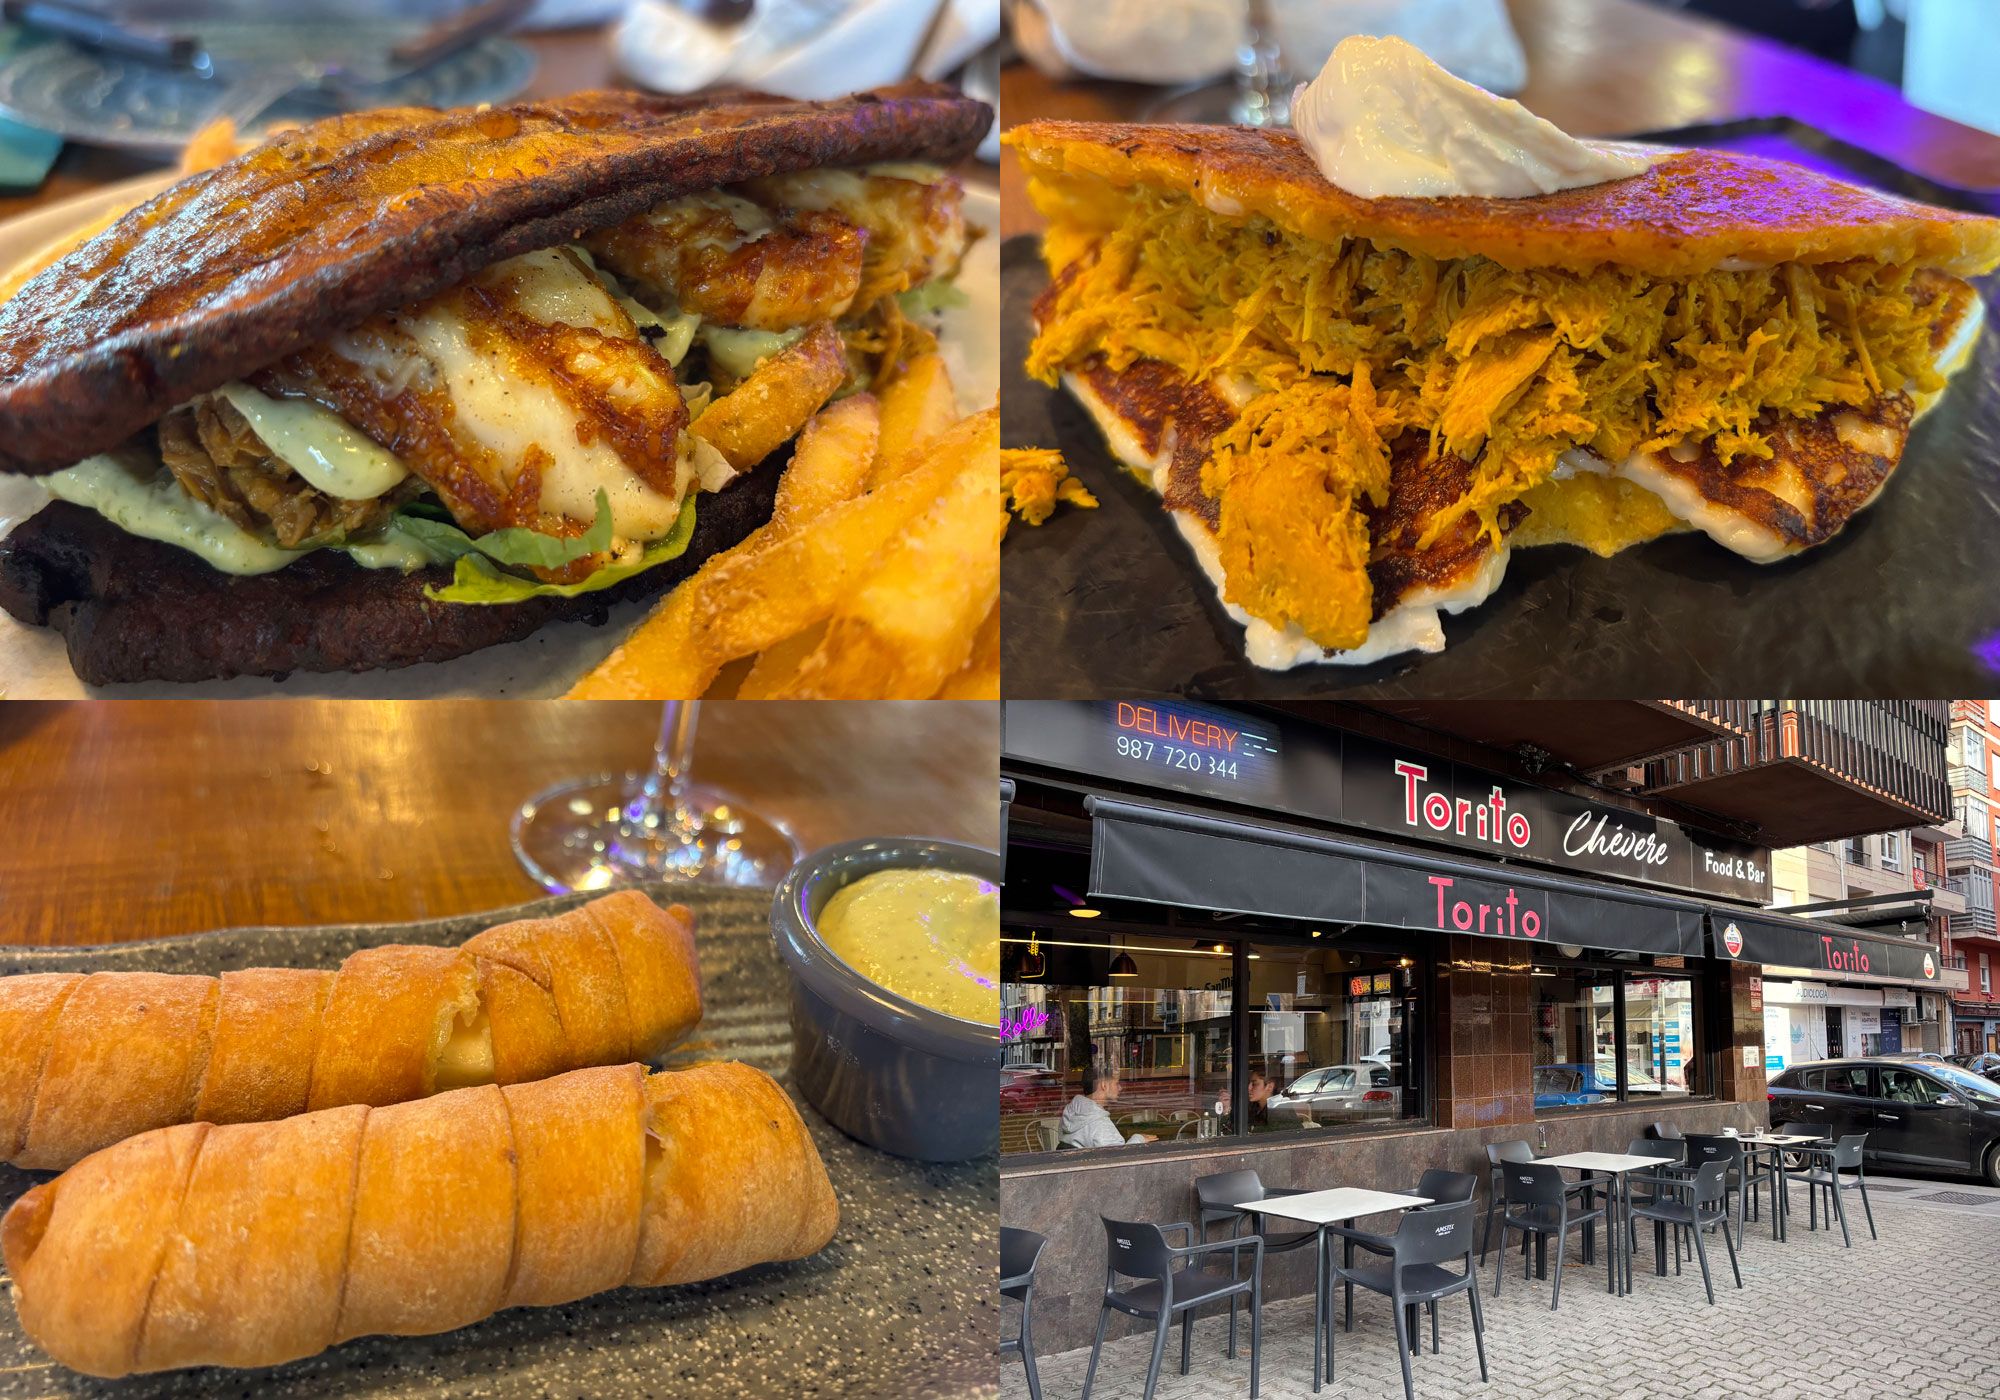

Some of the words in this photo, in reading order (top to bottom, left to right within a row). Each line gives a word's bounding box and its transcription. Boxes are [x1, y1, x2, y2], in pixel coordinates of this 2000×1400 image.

[1118, 702, 1238, 752] DELIVERY
[1117, 736, 1154, 761] 987
[1164, 746, 1201, 771] 720
[1209, 756, 1238, 780] 344
[1394, 759, 1531, 848] Torito
[1563, 810, 1669, 865] Chévere
[1705, 852, 1733, 878] Food
[1735, 859, 1746, 880] &
[1747, 861, 1765, 884] Bar
[1428, 876, 1541, 938] Torito
[1821, 936, 1869, 973] Torito
